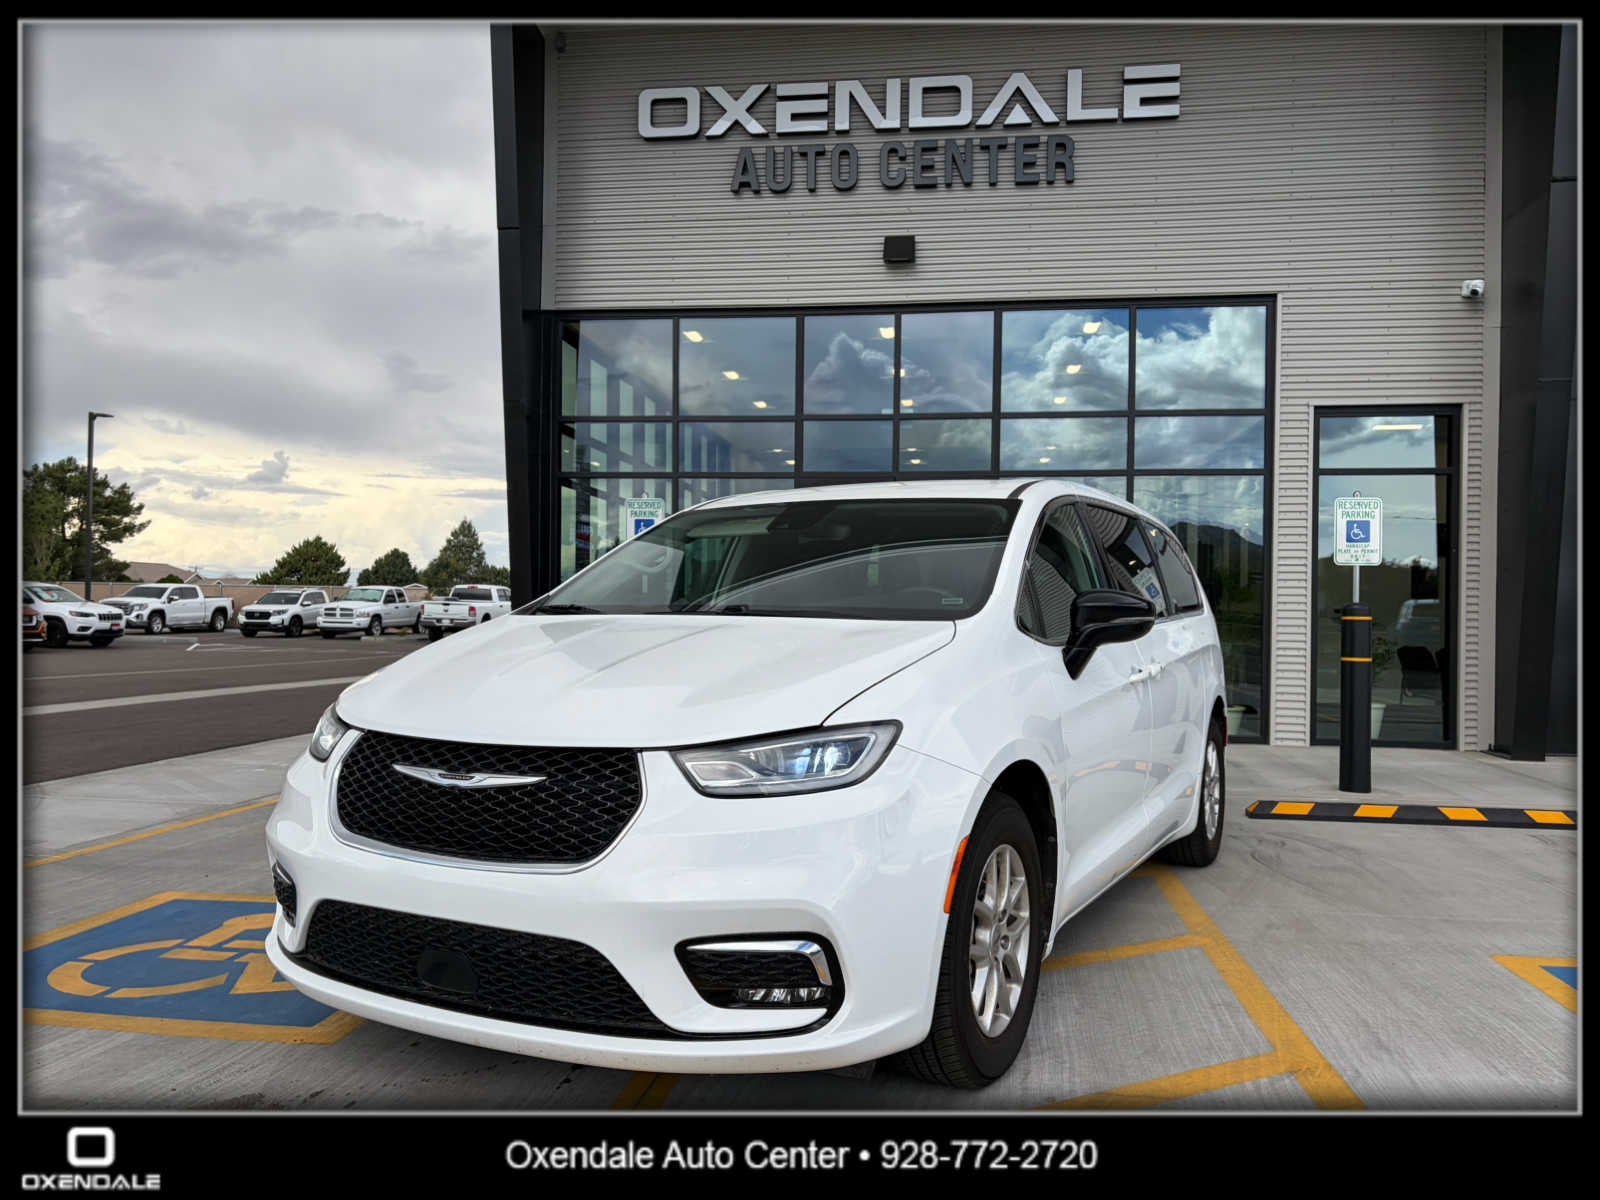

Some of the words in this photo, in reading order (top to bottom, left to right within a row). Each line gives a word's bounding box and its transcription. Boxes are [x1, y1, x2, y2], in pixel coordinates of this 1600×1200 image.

[638, 63, 1181, 139] OXENDALE
[731, 142, 858, 194] AUTO
[880, 135, 1076, 189] CENTER
[1338, 501, 1379, 510] RESERVED
[1342, 510, 1376, 519] PARKING
